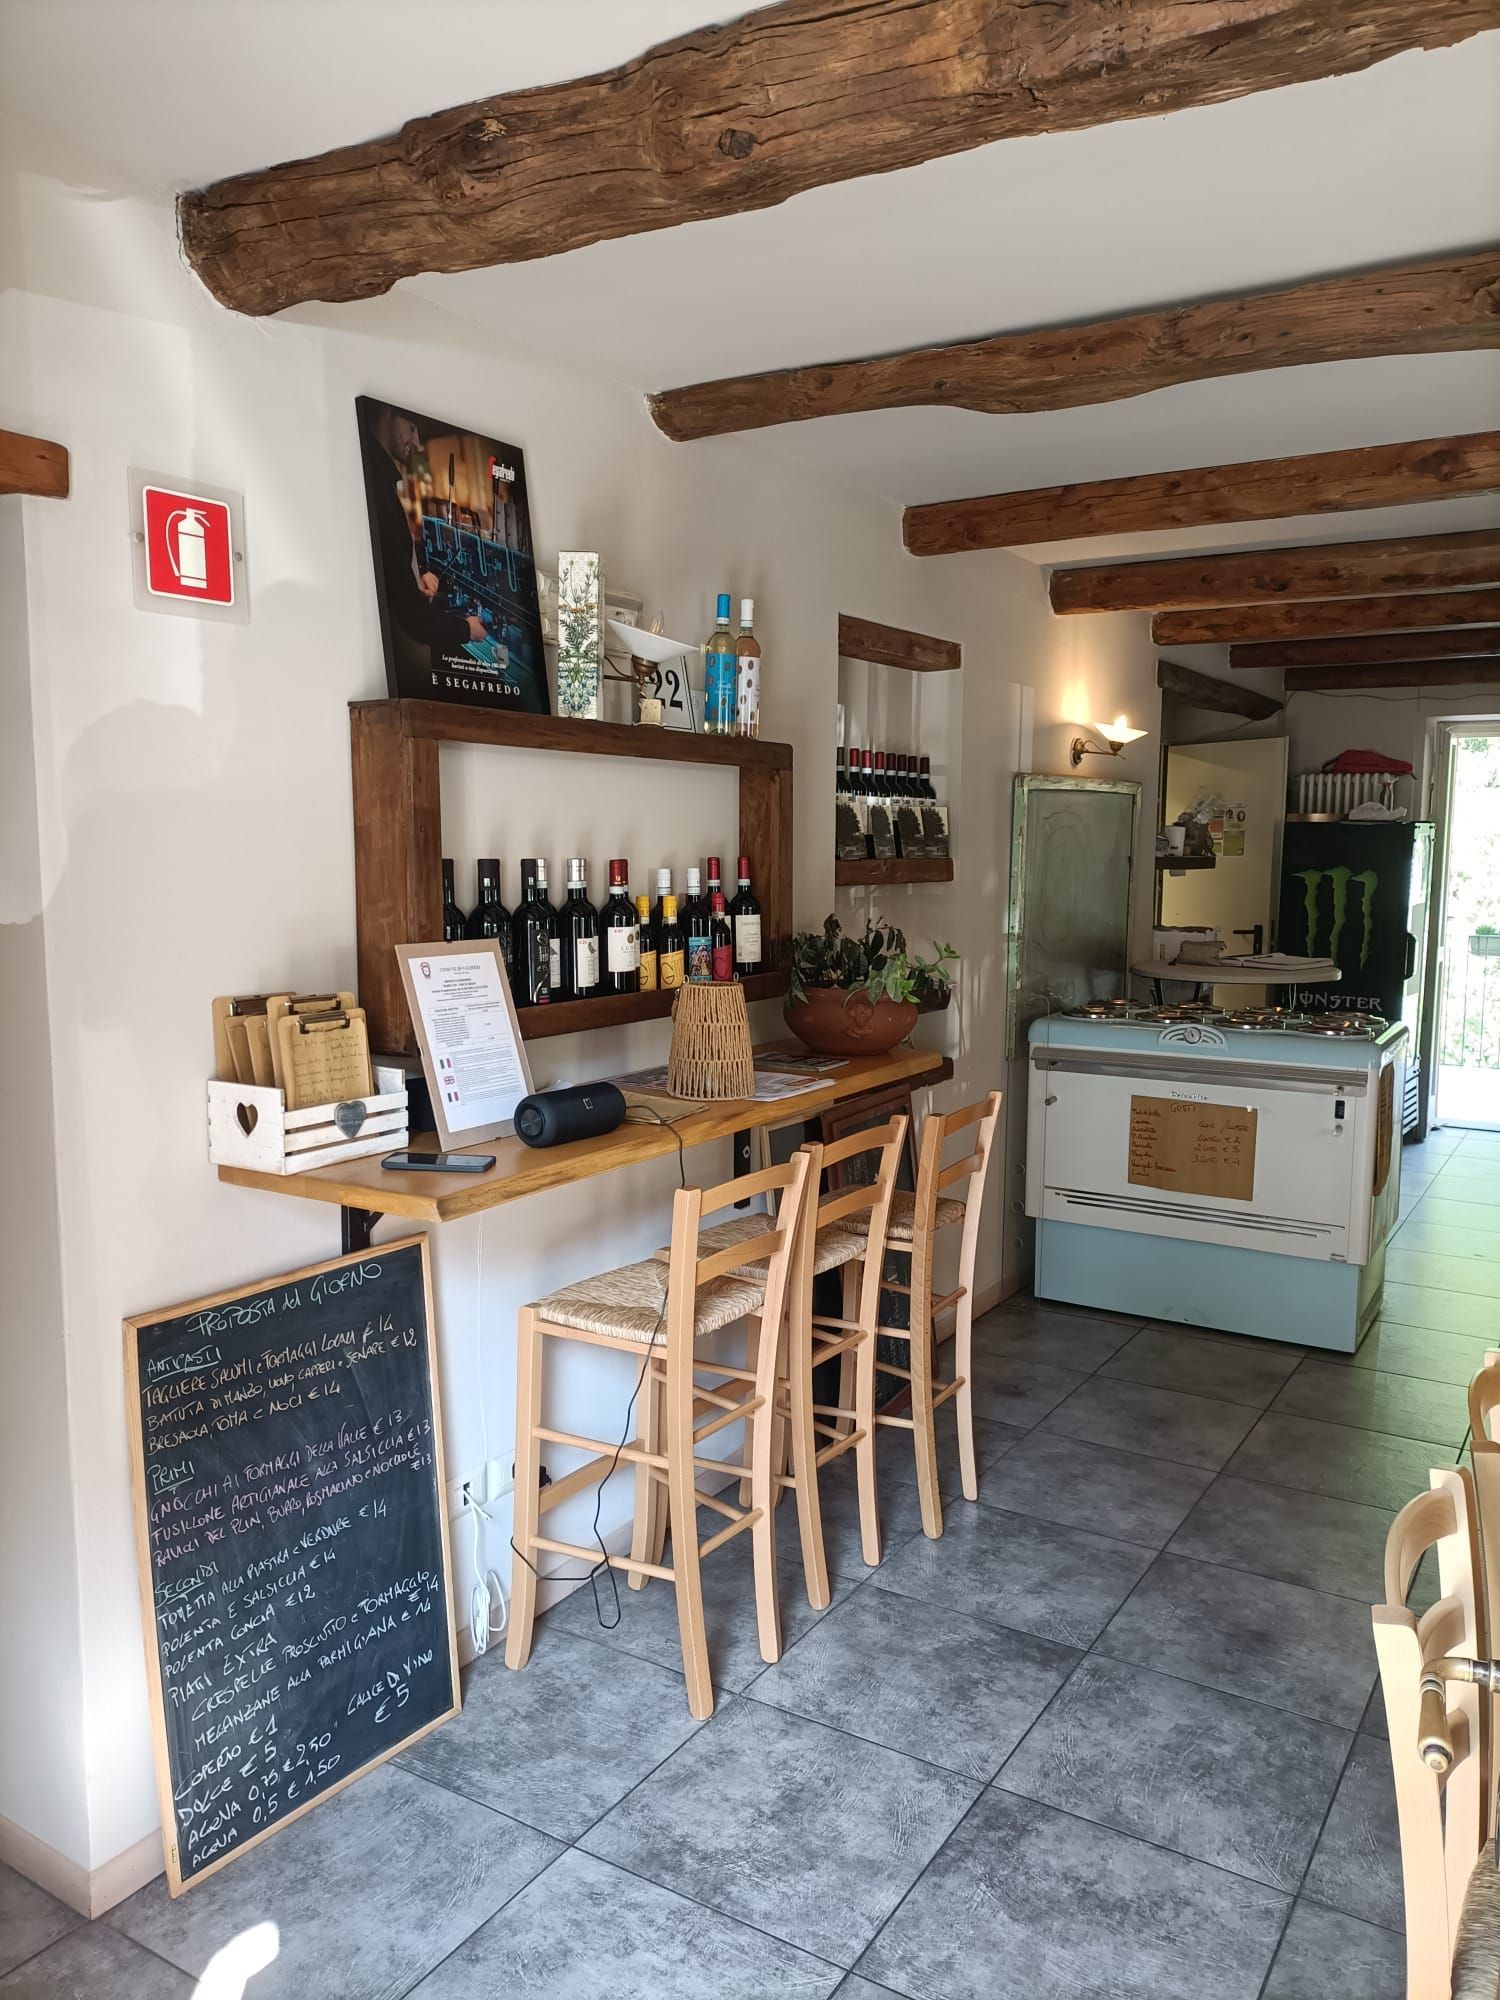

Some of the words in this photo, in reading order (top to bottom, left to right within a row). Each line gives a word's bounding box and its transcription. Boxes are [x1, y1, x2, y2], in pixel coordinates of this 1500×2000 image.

[446, 676, 520, 696] SEGAFREDO
[185, 1298, 276, 1336] PROPOSTA
[282, 1288, 301, 1310] del
[310, 1263, 382, 1304] GIORNO
[142, 1375, 206, 1408] TAGLIERE
[210, 1358, 253, 1389] SALUMI
[260, 1341, 318, 1370] FORMAGGI
[321, 1330, 356, 1352] LOCALI
[362, 1321, 374, 1344] €
[379, 1313, 394, 1333] 14
[146, 1401, 205, 1432] BATTUTA
[210, 1398, 222, 1410] DI
[298, 1359, 336, 1381] CAPPERI
[346, 1342, 386, 1368] SENAPE
[391, 1335, 400, 1348] €
[403, 1328, 417, 1347] 12
[147, 1345, 222, 1378] ANTIPASTI
[211, 1410, 248, 1431] TOMA
[269, 1394, 302, 1416] NOCI
[307, 1386, 320, 1400] €
[324, 1380, 340, 1396] 14
[147, 1460, 195, 1491] PRIMI
[150, 1484, 218, 1524] GNOCCHI
[222, 1474, 240, 1494] AI
[242, 1450, 300, 1483] FORMAGGI
[305, 1440, 334, 1462] DELLA
[338, 1421, 367, 1449] VALLE
[373, 1417, 383, 1435] €
[389, 1410, 402, 1427] 13
[151, 1506, 225, 1547] FUSILLONE
[231, 1474, 310, 1515] ARTIGIANALE
[315, 1460, 338, 1481] ALLA
[344, 1435, 403, 1468] SALSICCIA
[408, 1428, 415, 1441] €
[416, 1420, 431, 1435] 13
[410, 1461, 420, 1471] €
[421, 1453, 432, 1466] 13
[152, 1539, 200, 1567] RAVIOLI
[204, 1528, 226, 1544] DEL
[306, 1474, 363, 1509] ROSMARINO
[157, 1591, 215, 1630] TOMETTA
[221, 1576, 244, 1595] ALLA
[247, 1548, 289, 1579] PIASTRA
[300, 1517, 352, 1548] VERDURE
[359, 1505, 369, 1517] €
[373, 1498, 386, 1518] 14
[155, 1561, 219, 1608] SECONDI
[161, 1618, 221, 1656] POLENTA
[243, 1565, 306, 1608] SALSICCIA
[310, 1554, 320, 1569] €
[324, 1548, 336, 1563] 14
[408, 1588, 421, 1602] €
[427, 1574, 439, 1592] 14
[165, 1637, 224, 1678] POLENTA
[230, 1603, 275, 1640] CONCIA
[285, 1592, 298, 1607] €
[298, 1584, 315, 1603] 12
[167, 1672, 213, 1708] PIATTI
[223, 1632, 277, 1675] EXTRA
[192, 1657, 277, 1721] CRESPELLE
[281, 1616, 347, 1664] PROSCIUTTO
[357, 1570, 429, 1614] FORMAGGIO
[194, 1685, 281, 1752] MELANZANE
[287, 1669, 311, 1691] ALLA
[317, 1615, 397, 1669] PARMIGIANA
[401, 1610, 411, 1621] €
[415, 1597, 430, 1616] 14
[347, 1681, 385, 1716] CALICE
[386, 1671, 401, 1688] DI
[403, 1649, 433, 1677] VINO
[375, 1696, 392, 1724] €
[397, 1683, 409, 1708] 5
[175, 1745, 242, 1800] COPERTO
[248, 1727, 263, 1745] €
[265, 1713, 278, 1736] 1
[177, 1777, 233, 1827] DOLCE
[239, 1753, 258, 1778] €
[264, 1740, 277, 1763] 5
[188, 1801, 242, 1851] ACQUA
[282, 1758, 294, 1772] €
[192, 1828, 238, 1868] ACQUA
[287, 1781, 300, 1799] €
